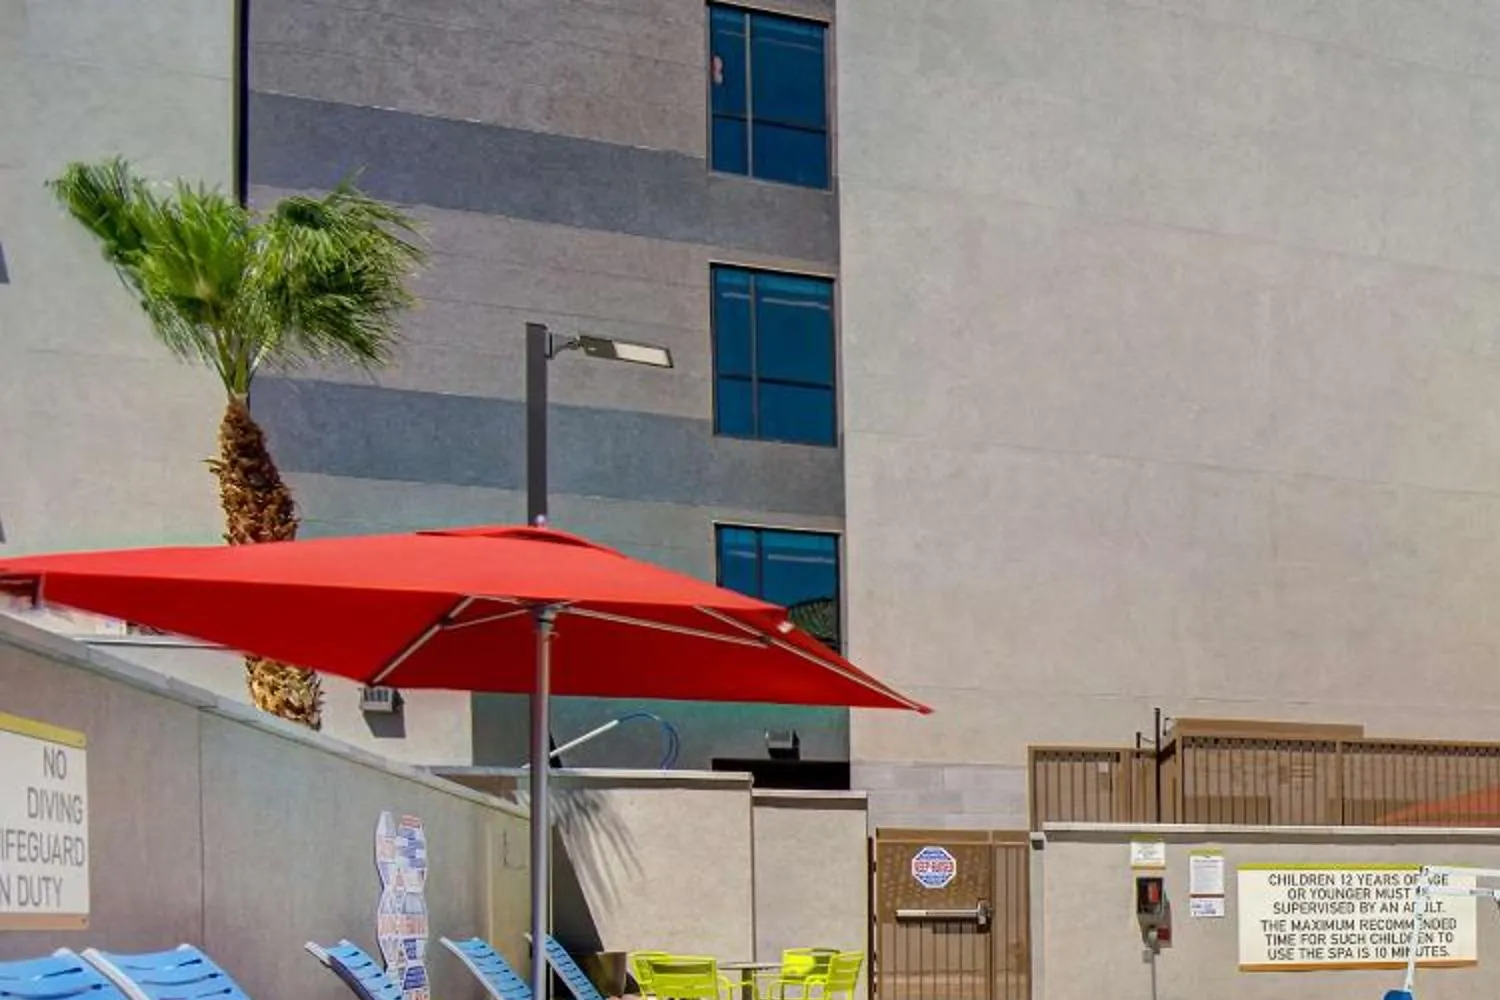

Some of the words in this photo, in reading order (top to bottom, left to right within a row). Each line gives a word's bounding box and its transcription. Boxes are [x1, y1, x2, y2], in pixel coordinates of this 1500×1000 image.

[43, 747, 67, 780] NO
[27, 787, 83, 825] DIVING
[0, 828, 85, 868] IFEGUARD
[1268, 873, 1335, 886] CHILDREN
[1341, 873, 1353, 886] 12
[1359, 874, 1400, 886] YEARS
[18, 875, 63, 908] DUTY
[1287, 888, 1306, 900] OR
[1310, 888, 1371, 900] YOUNGER
[1375, 888, 1411, 899] MUST
[1273, 902, 1355, 914] SUPERVISED
[1359, 902, 1376, 913] BY
[1380, 901, 1399, 913] AN
[1260, 919, 1286, 932] THE
[1291, 919, 1355, 931] MAXIMUM
[1265, 933, 1297, 946] TIME
[1301, 933, 1327, 945] FOR
[1330, 933, 1367, 945] SUCH
[1438, 931, 1454, 943] TO
[1267, 947, 1295, 961] USE
[1298, 947, 1325, 959] THE
[1327, 947, 1353, 959] SPA
[1357, 947, 1370, 959] IS
[1375, 946, 1388, 959] 10
